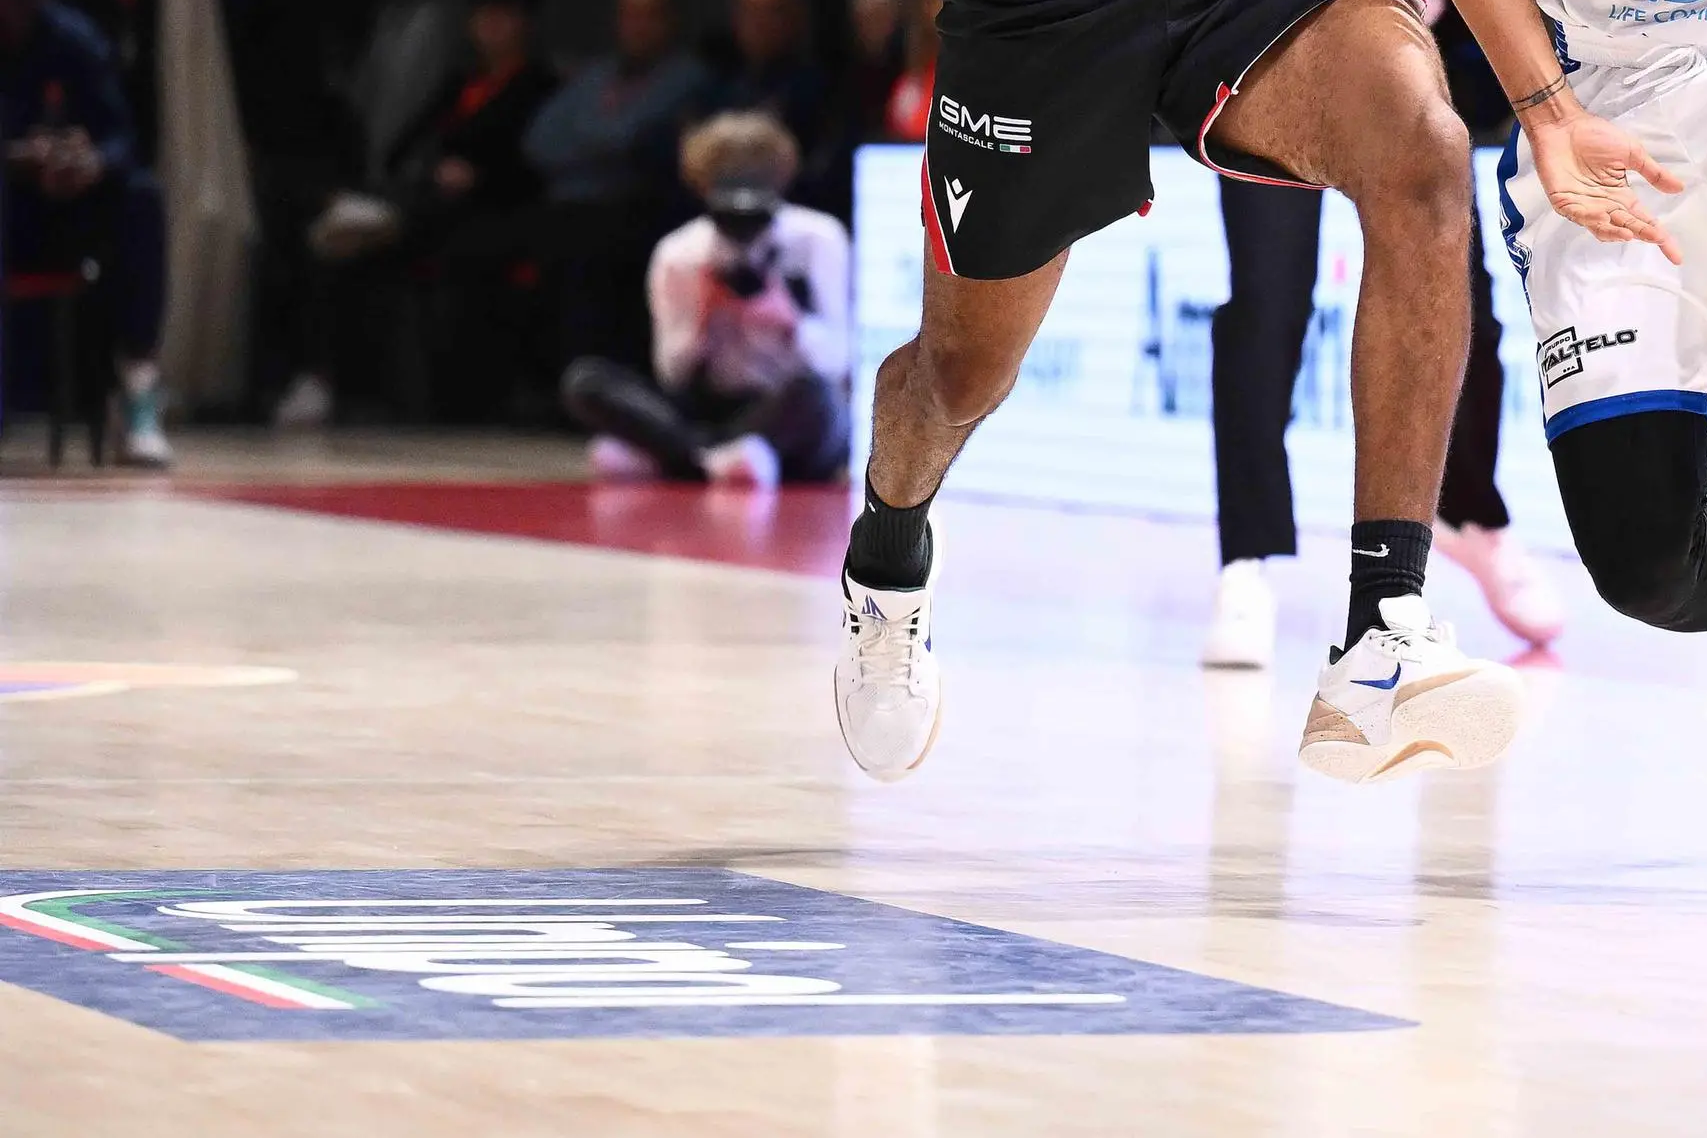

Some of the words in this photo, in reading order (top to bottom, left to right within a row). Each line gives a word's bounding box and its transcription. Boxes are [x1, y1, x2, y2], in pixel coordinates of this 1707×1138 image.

[1609, 4, 1646, 22] LIFE
[939, 94, 1033, 142] GME
[938, 120, 994, 150] MONTASCALE
